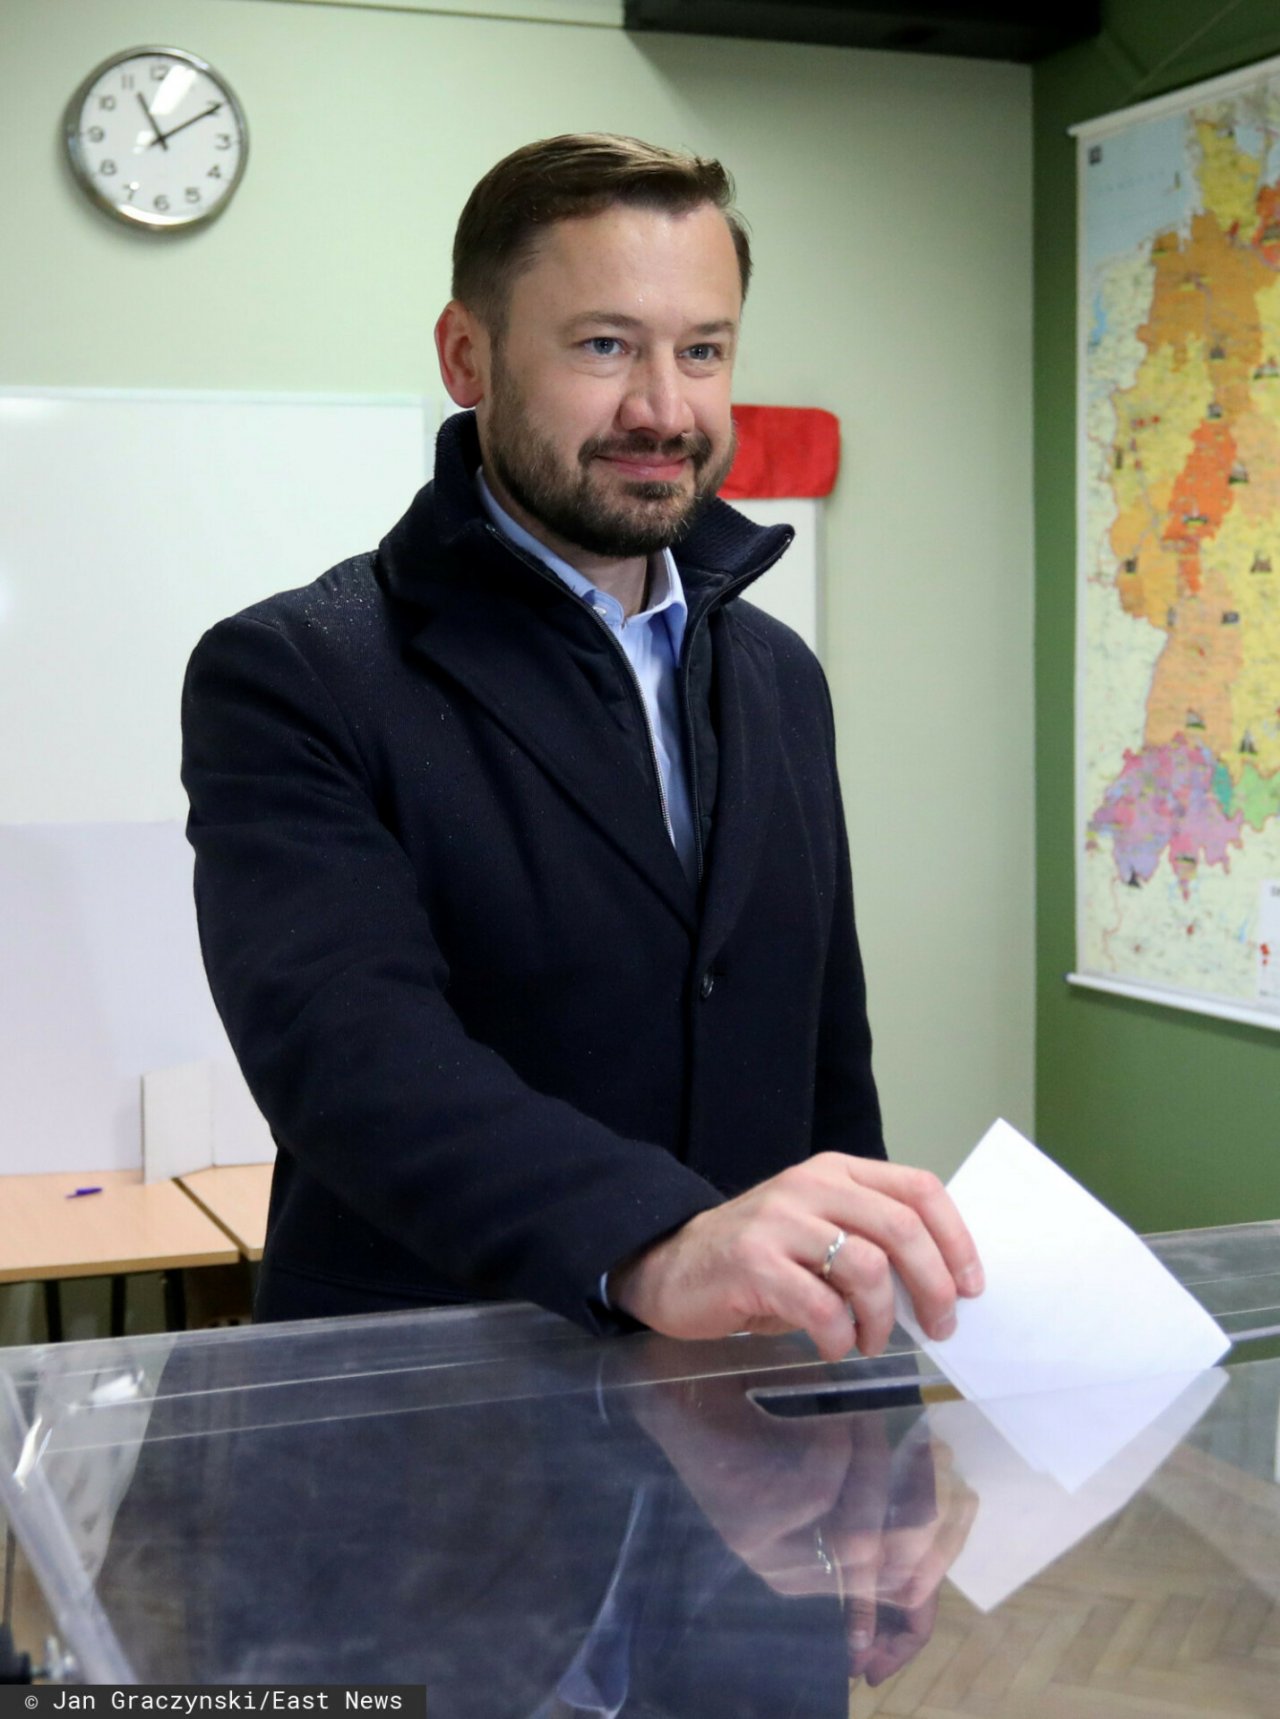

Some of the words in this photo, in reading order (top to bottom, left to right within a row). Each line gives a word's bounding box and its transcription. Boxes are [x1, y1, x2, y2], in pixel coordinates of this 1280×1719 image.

[121, 74, 135, 90] 11
[98, 96, 116, 111] 10
[88, 126, 105, 143] 9
[215, 133, 231, 150] 3
[100, 159, 117, 176] 8
[206, 165, 222, 179] 4
[153, 194, 170, 212] 6
[185, 187, 201, 204] 5
